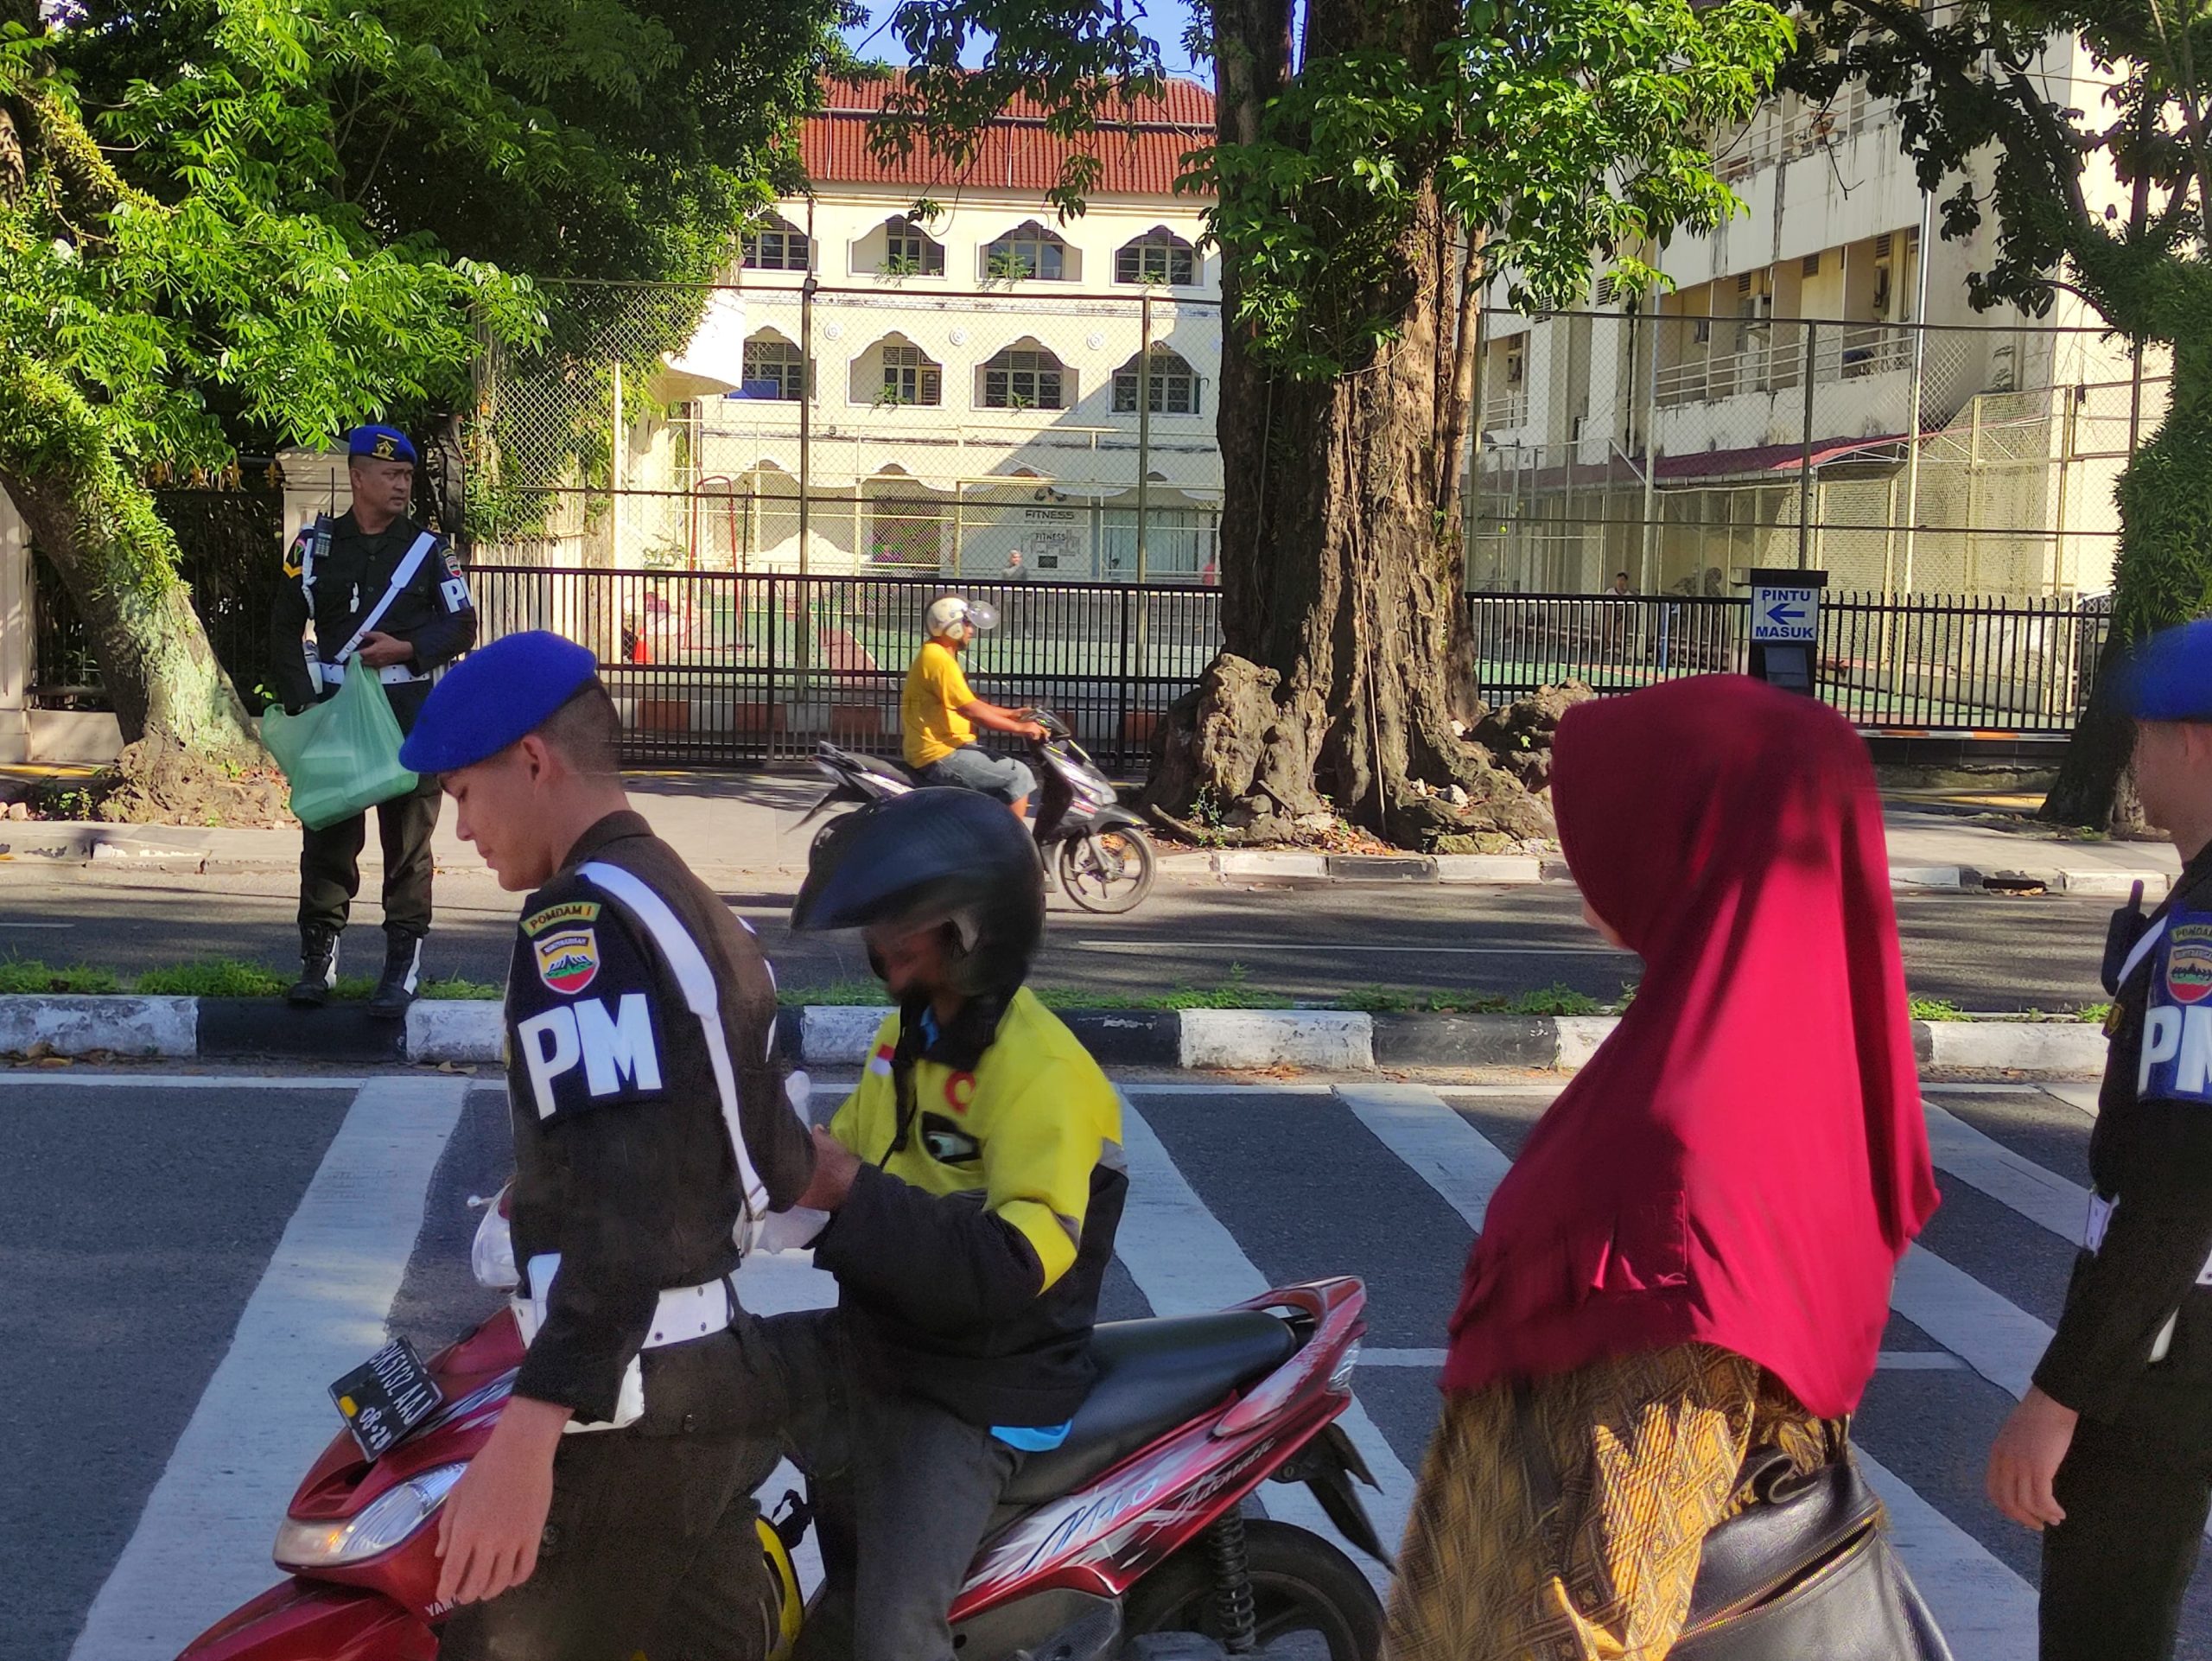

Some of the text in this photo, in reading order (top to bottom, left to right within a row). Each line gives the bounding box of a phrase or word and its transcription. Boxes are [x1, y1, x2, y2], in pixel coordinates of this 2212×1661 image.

[1025, 509, 1075, 519] FITNESS
[1762, 589, 1811, 601] PINTU
[1755, 626, 1814, 639] MASUK
[530, 905, 582, 930] POMDAM
[518, 993, 663, 1120] PM
[392, 1382, 433, 1426] AAJ
